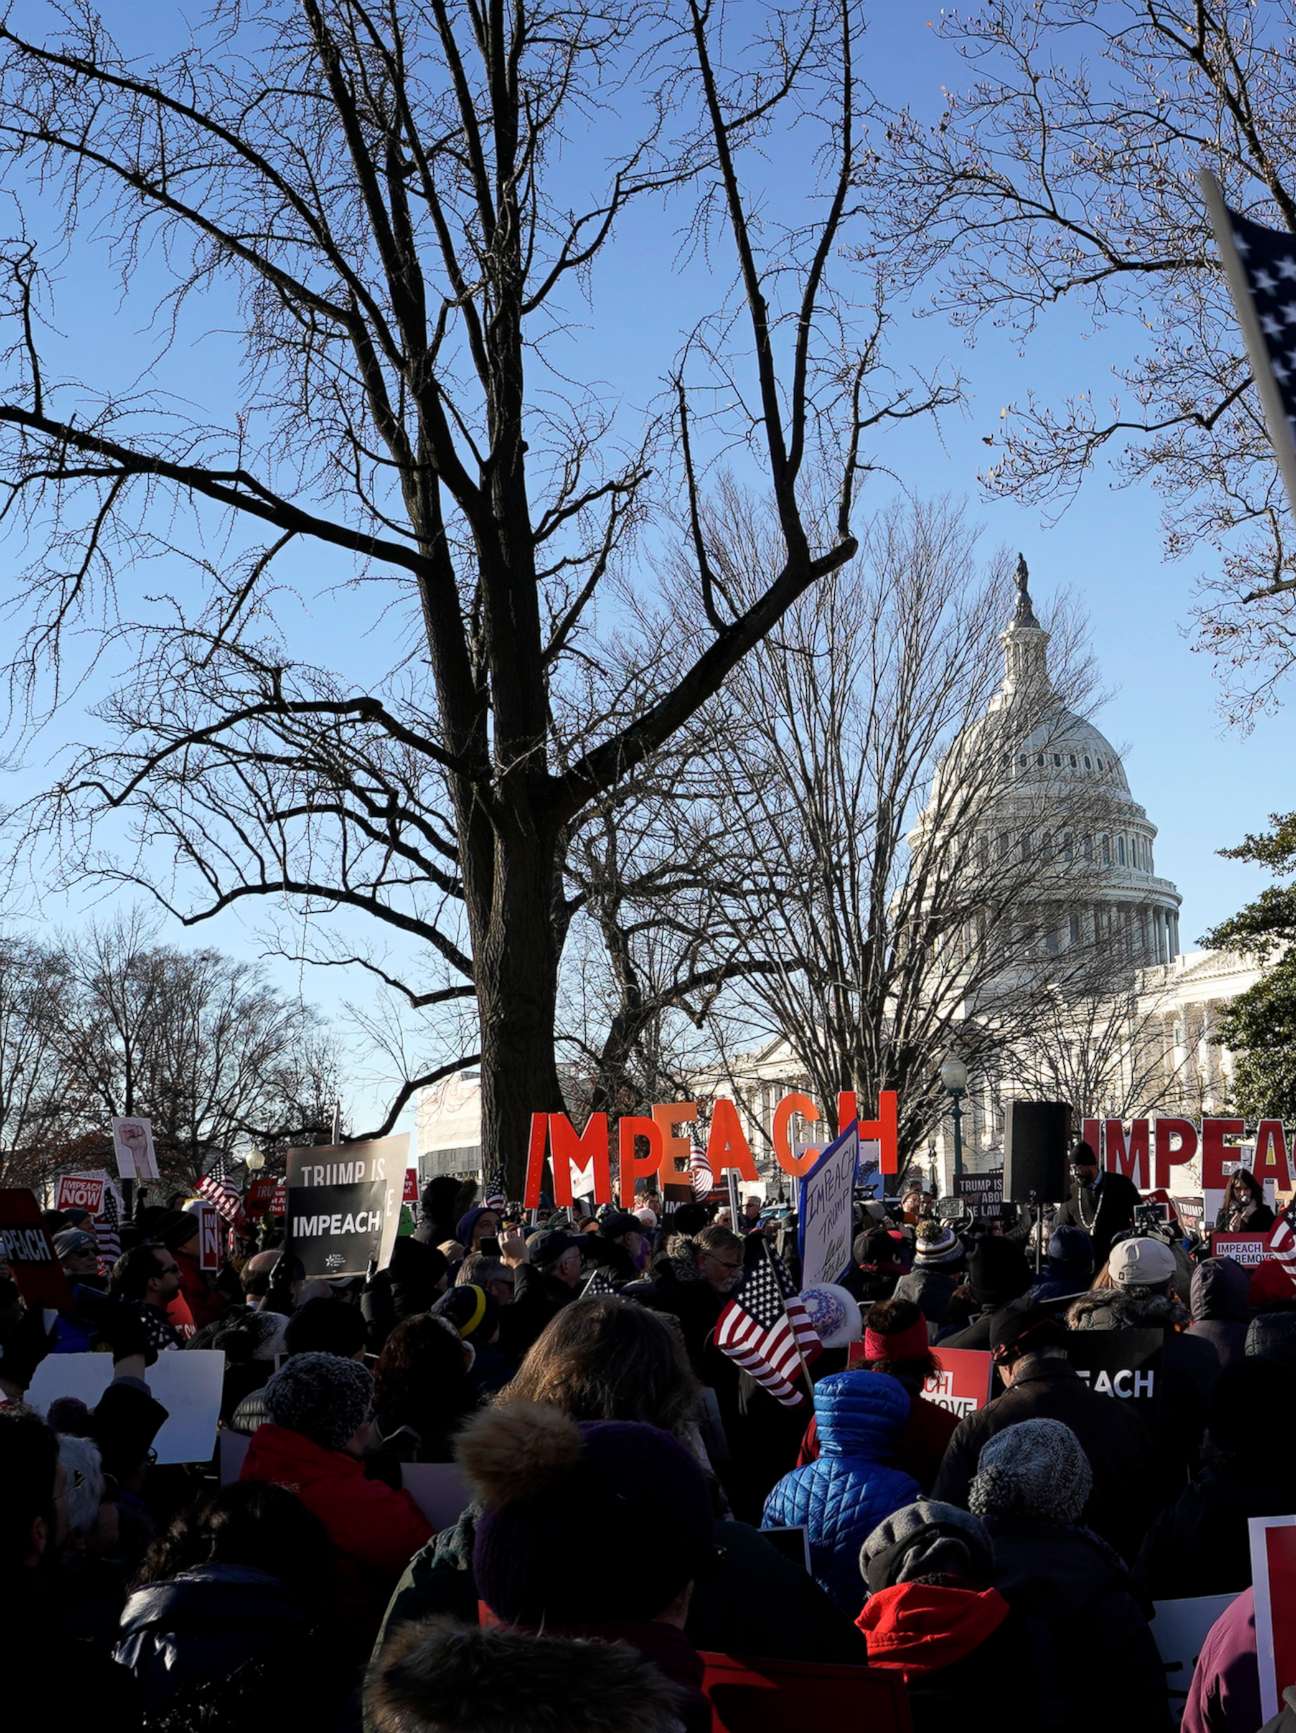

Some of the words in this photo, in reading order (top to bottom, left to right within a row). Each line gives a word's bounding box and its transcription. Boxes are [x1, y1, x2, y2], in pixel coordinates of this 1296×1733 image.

[523, 1090, 898, 1209] IMPEACH
[301, 1161, 365, 1187] TRUMP
[372, 1158, 385, 1181] IS
[63, 1180, 102, 1193] IMPEACH
[807, 1144, 855, 1227] IMPEACH
[960, 1180, 991, 1191] TRUMP
[994, 1179, 1002, 1190] IS
[61, 1189, 100, 1206] NOW
[982, 1192, 1003, 1203] ABO
[981, 1204, 1001, 1217] LAW
[292, 1210, 381, 1237] IMPEACH
[2, 1228, 52, 1261] PEACH
[1217, 1244, 1262, 1254] IMPEACH
